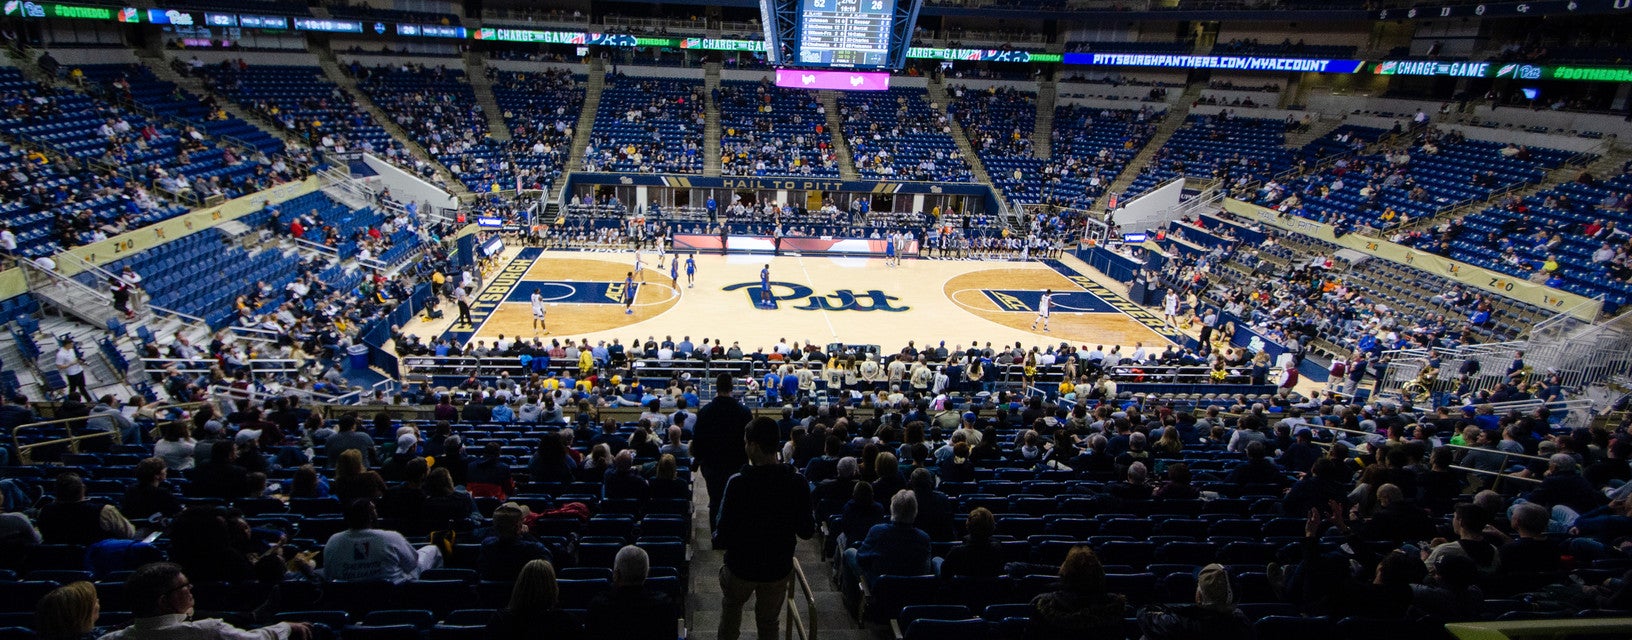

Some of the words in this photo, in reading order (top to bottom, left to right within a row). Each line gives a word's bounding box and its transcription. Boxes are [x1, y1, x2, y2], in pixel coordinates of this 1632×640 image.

[871, 0, 883, 10] 26
[213, 15, 230, 26] 52
[402, 25, 416, 36] 26
[497, 28, 534, 42] CHARGE
[702, 38, 737, 51] CHARGE
[905, 47, 934, 59] HARGE
[1092, 53, 1330, 72] PITTSBURGHPANTHERS.COM/MYACCOUNT
[1397, 61, 1438, 76] CHARGE
[1450, 62, 1489, 78] GAME
[723, 179, 765, 189] HAIL
[773, 180, 796, 190] TO
[803, 181, 843, 191] PITT
[448, 259, 534, 333] PITTSBURGH
[721, 280, 912, 313] Pitt
[1068, 275, 1181, 337] PANTHERS
